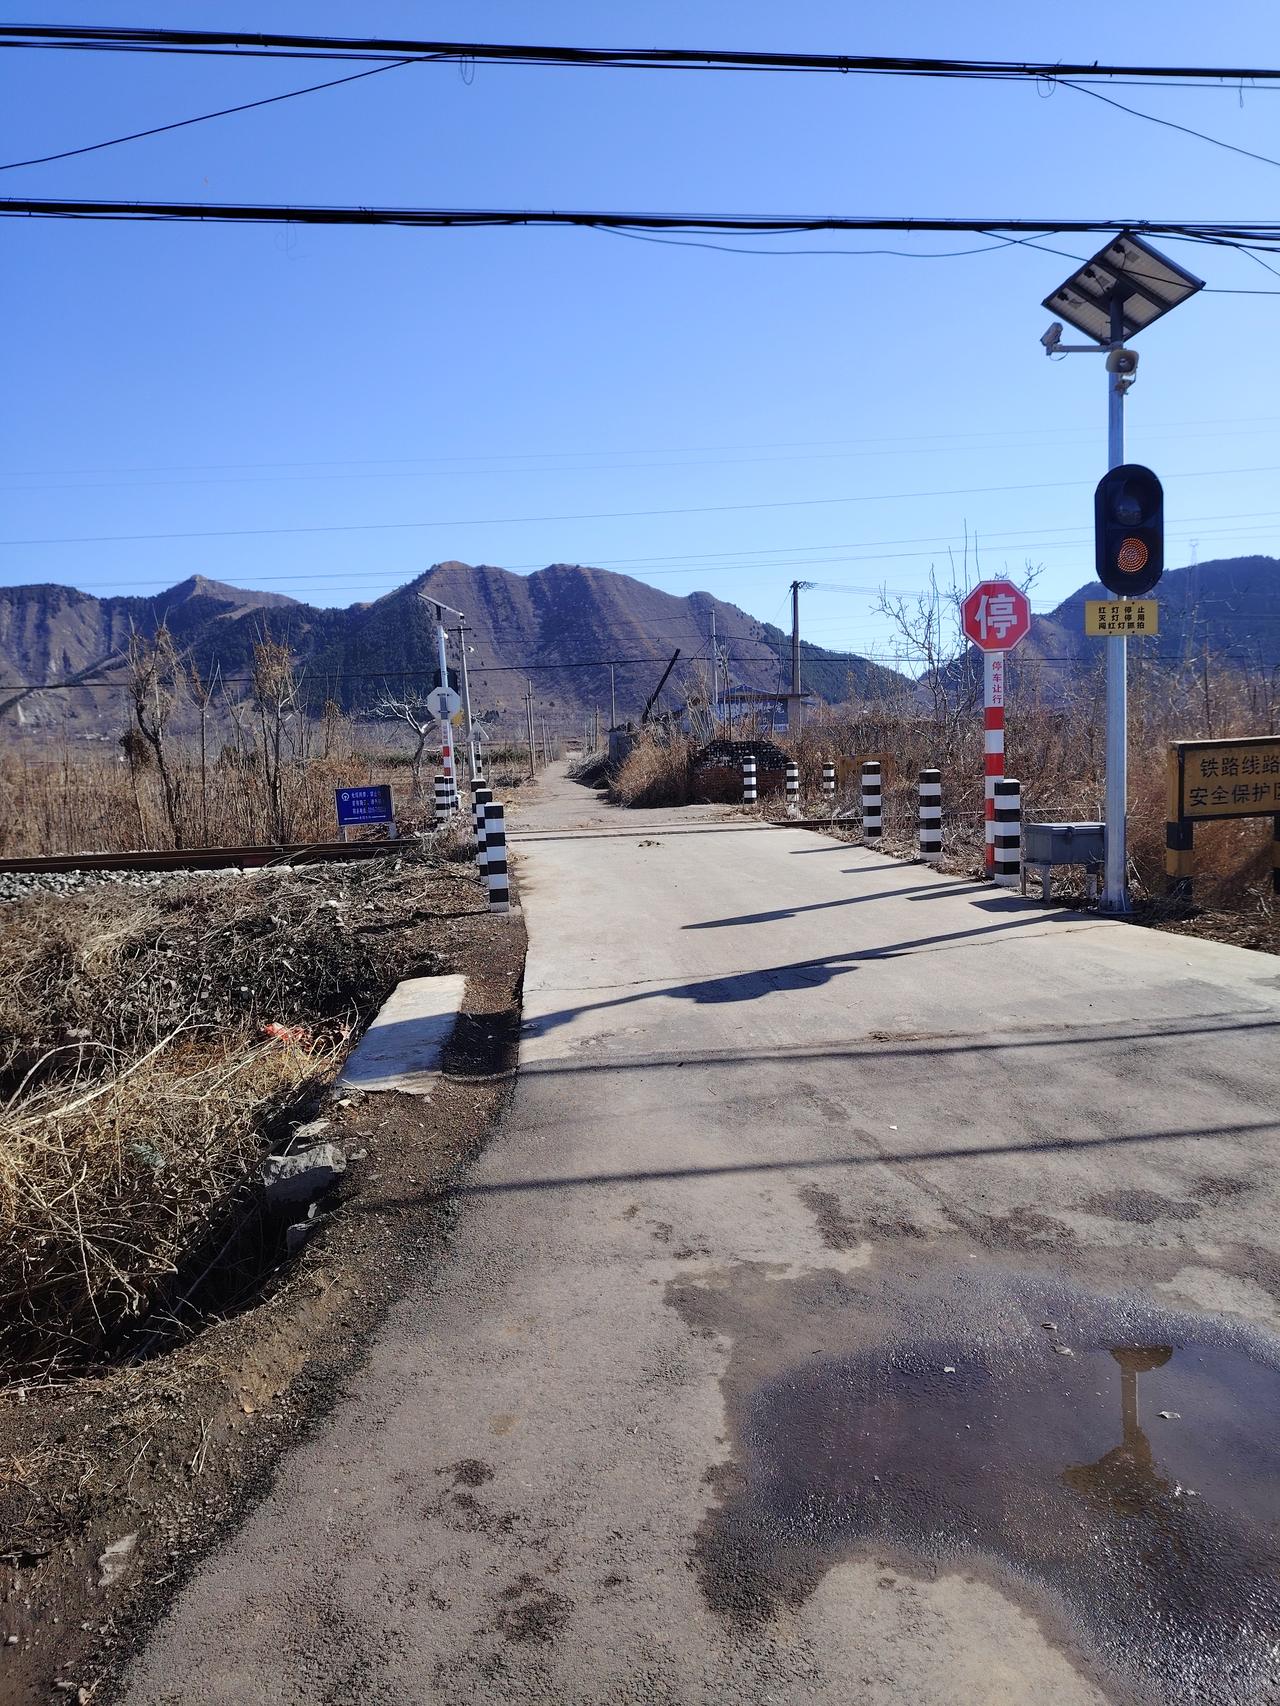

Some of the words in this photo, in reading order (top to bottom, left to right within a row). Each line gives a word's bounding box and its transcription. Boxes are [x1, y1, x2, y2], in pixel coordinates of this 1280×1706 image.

[974, 593, 1018, 640] 停
[992, 661, 1002, 704] 停车让行
[1200, 755, 1280, 778] 铁路线路
